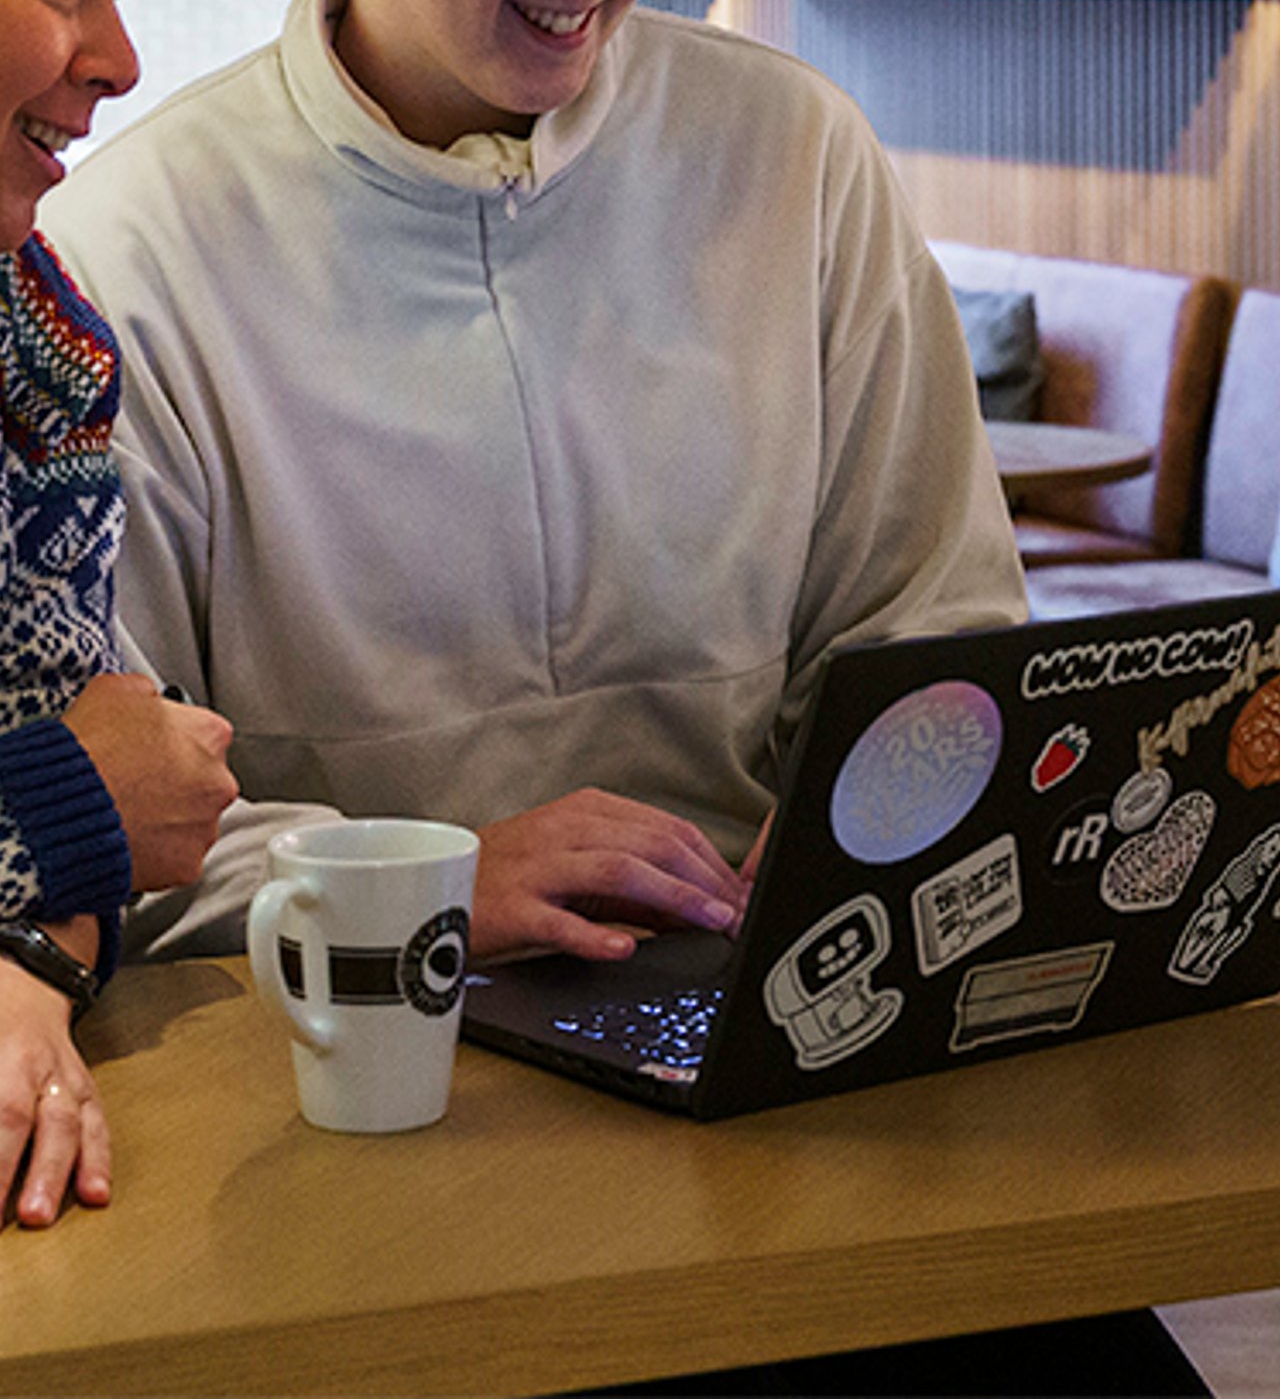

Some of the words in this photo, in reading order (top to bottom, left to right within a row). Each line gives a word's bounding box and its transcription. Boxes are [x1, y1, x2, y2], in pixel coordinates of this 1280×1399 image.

[1023, 650, 1112, 696] WOW
[1112, 640, 1161, 680] NO
[1162, 621, 1251, 674] COW!
[886, 716, 935, 772] 20
